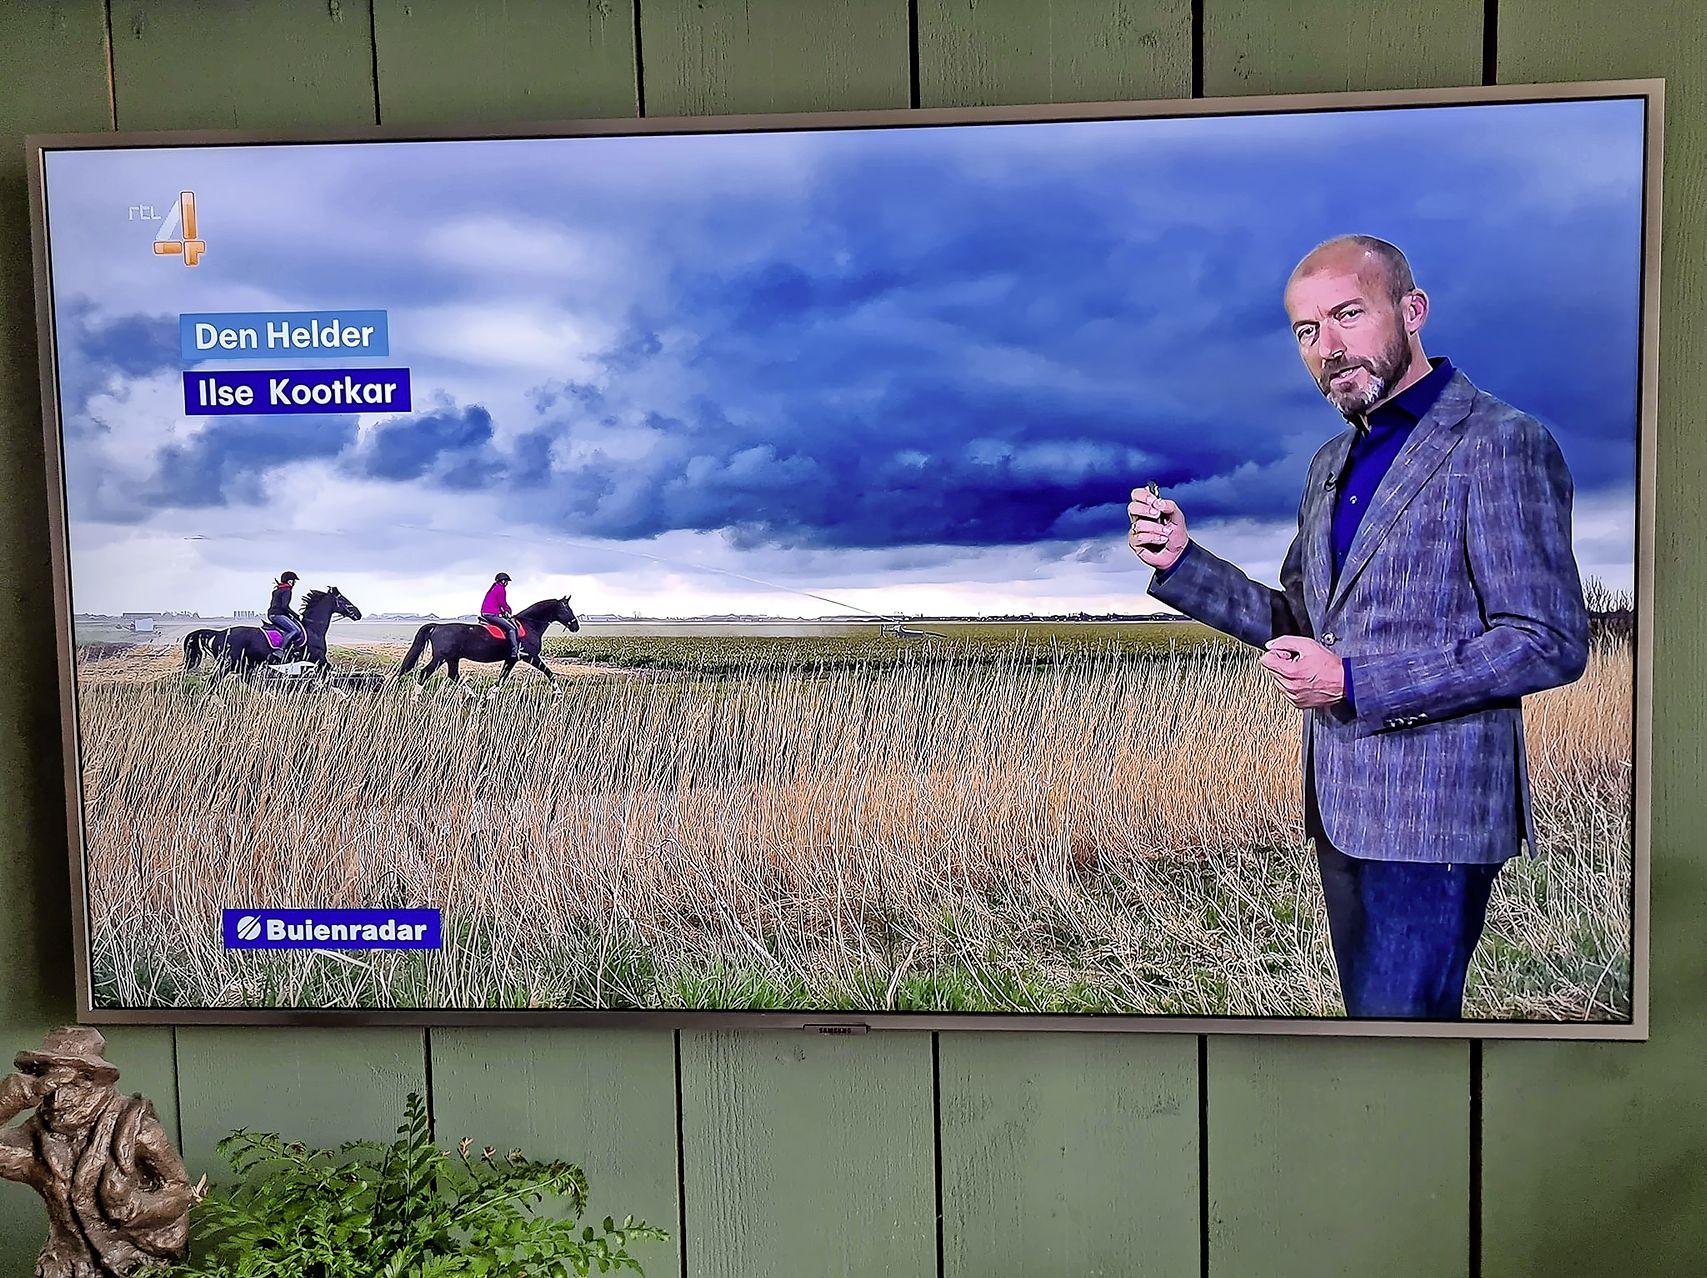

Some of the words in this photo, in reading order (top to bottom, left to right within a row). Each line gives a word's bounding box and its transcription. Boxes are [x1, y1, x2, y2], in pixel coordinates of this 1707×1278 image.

[152, 190, 206, 267] 4
[195, 322, 258, 350] Den
[266, 319, 374, 349] Helder
[199, 378, 254, 406] Ilse
[269, 376, 397, 405] Kootkar
[266, 919, 427, 941] Buienradar
